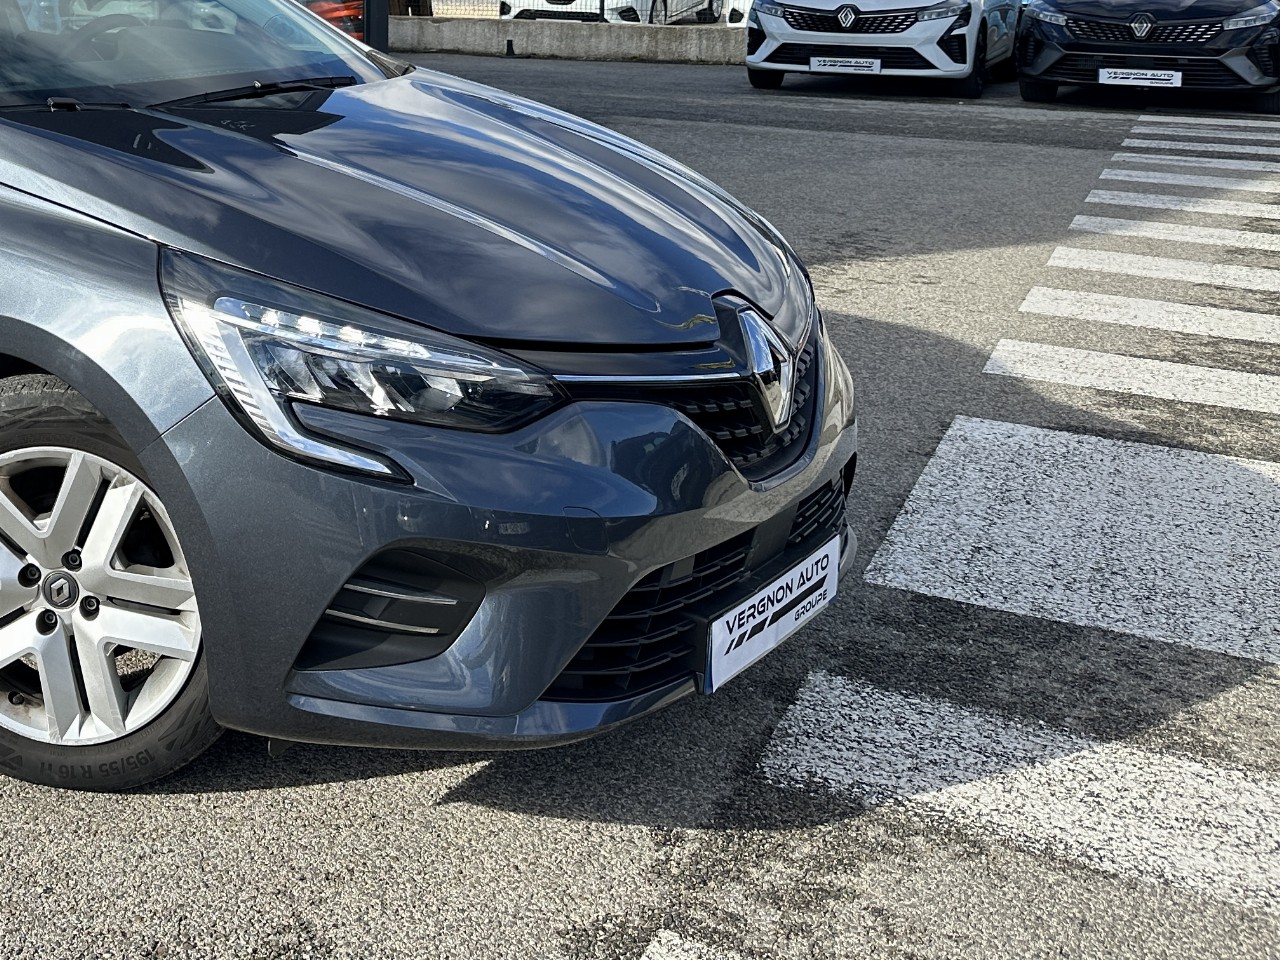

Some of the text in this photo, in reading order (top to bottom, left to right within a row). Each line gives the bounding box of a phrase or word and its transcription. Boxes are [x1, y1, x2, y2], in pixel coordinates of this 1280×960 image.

[725, 553, 830, 635] VERGNON AUTO
[794, 589, 828, 622] GROUPE
[99, 747, 157, 777] 195/55
